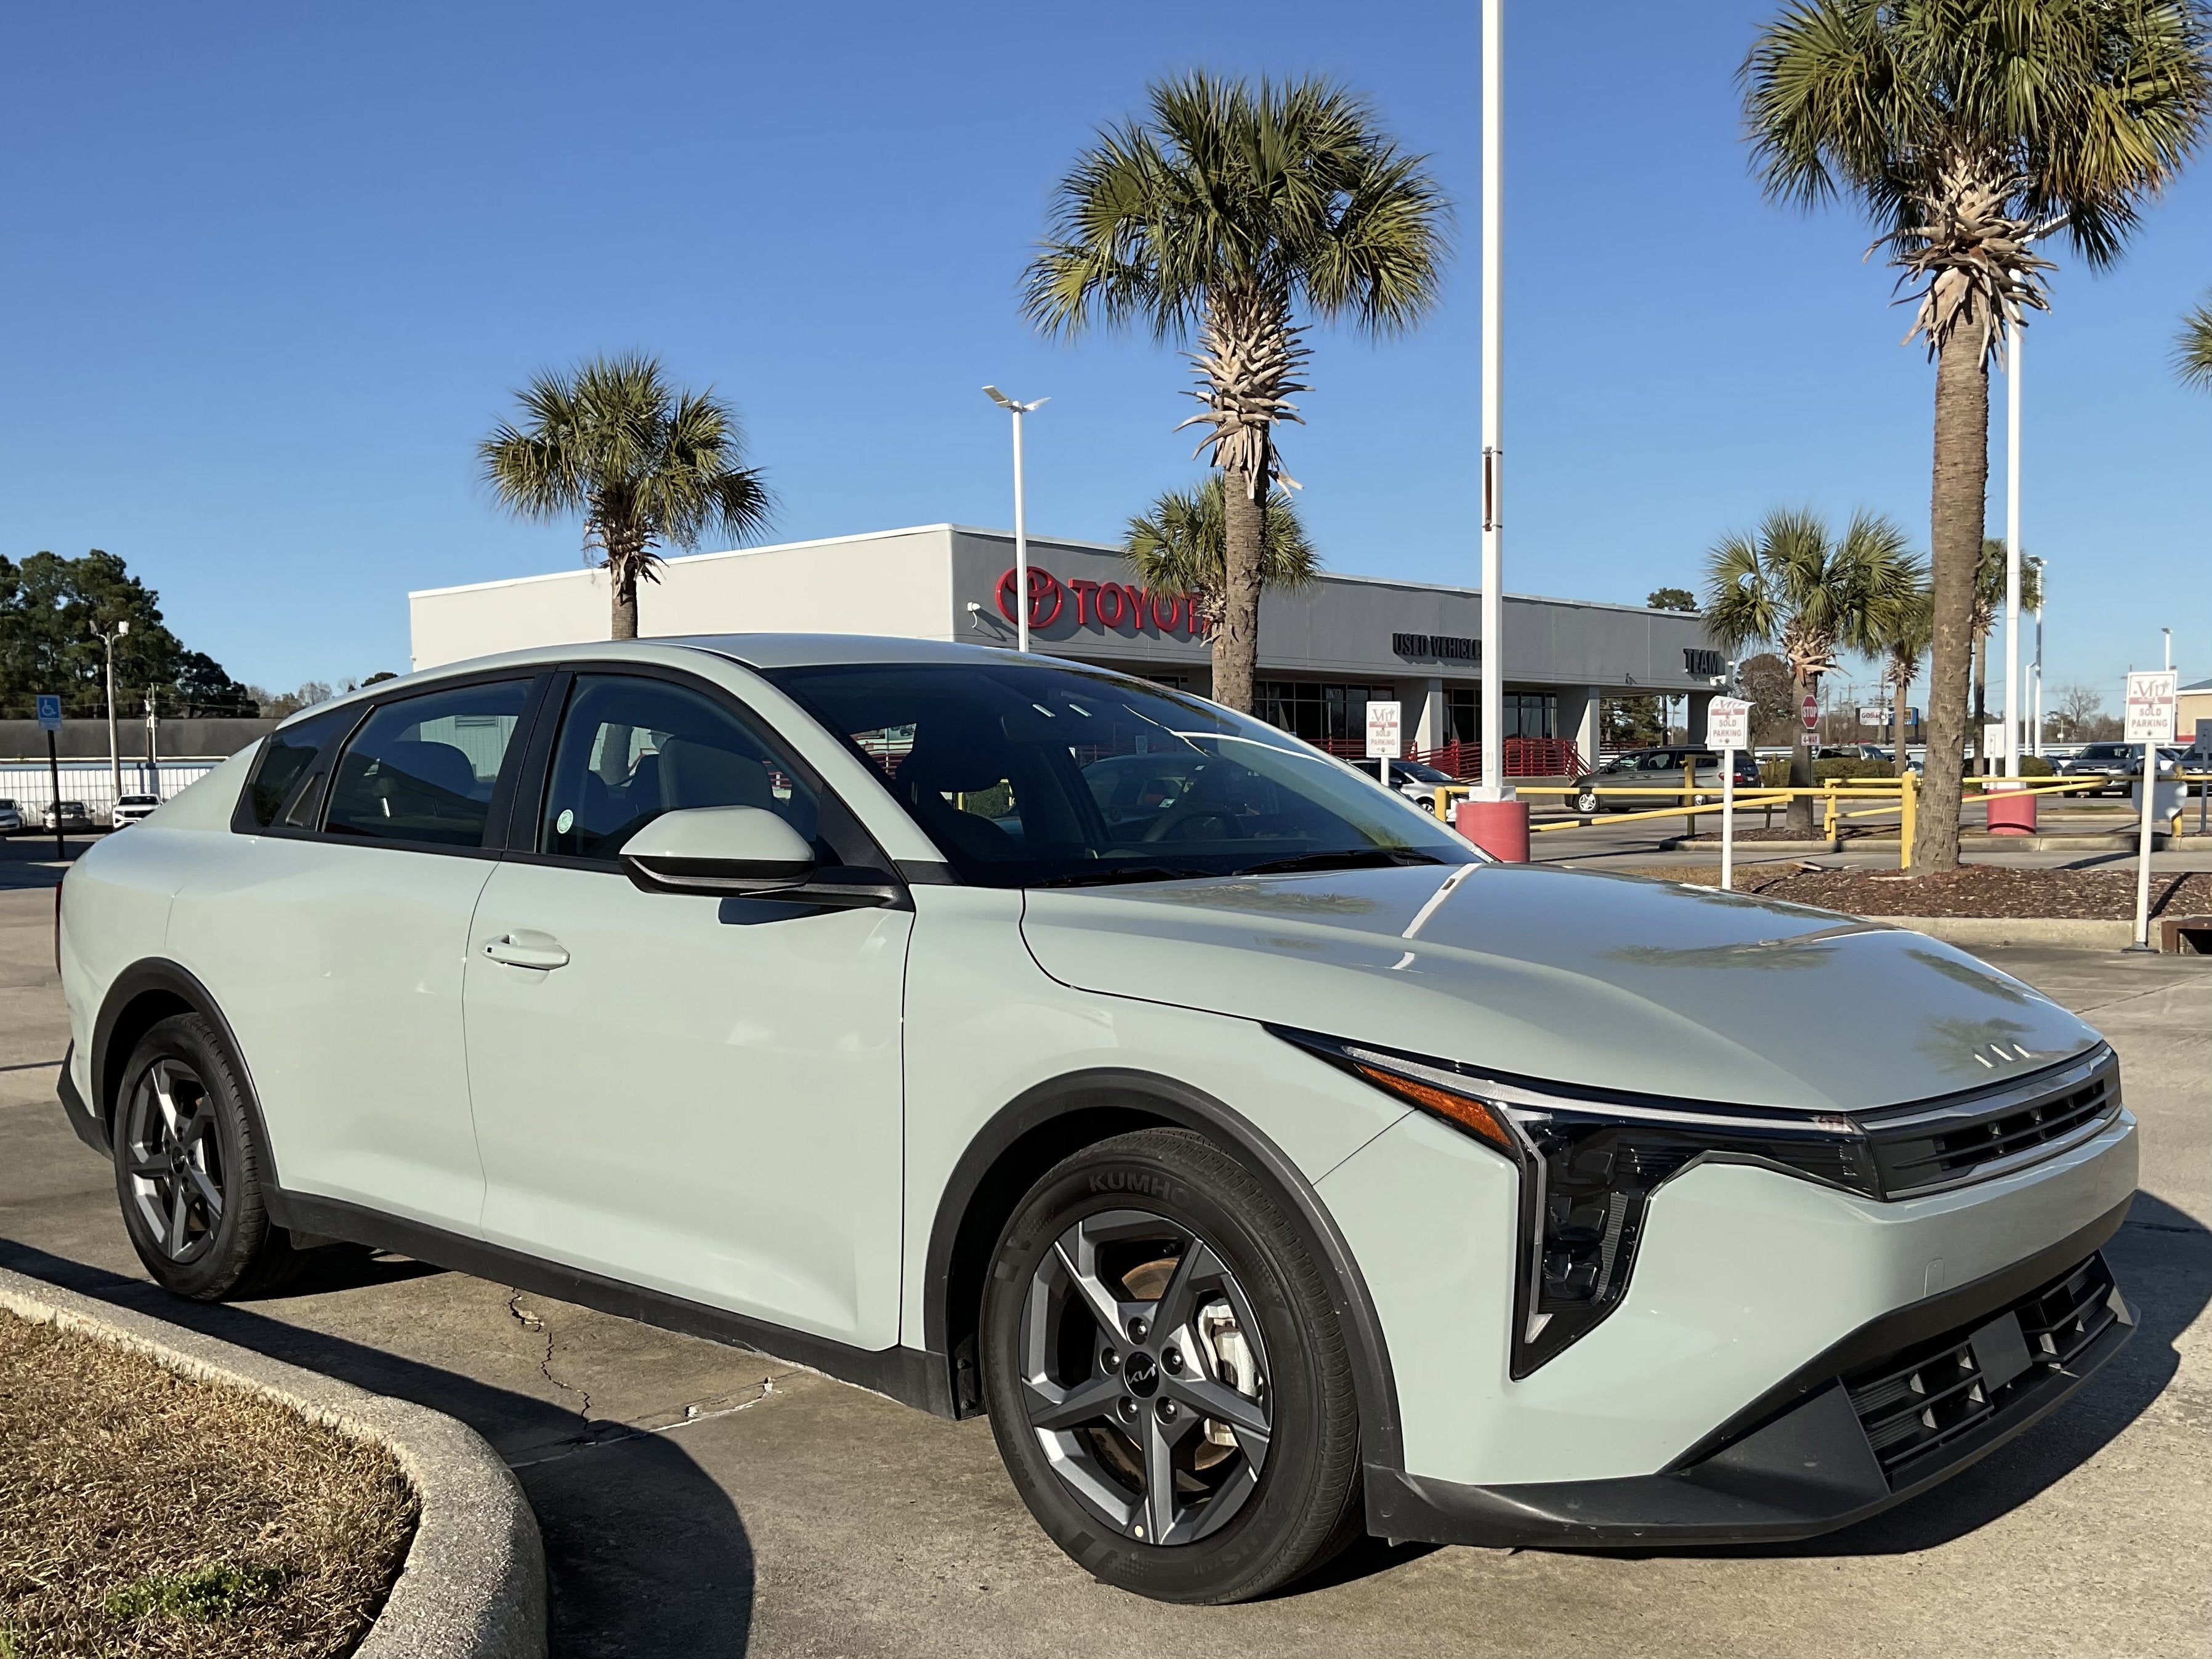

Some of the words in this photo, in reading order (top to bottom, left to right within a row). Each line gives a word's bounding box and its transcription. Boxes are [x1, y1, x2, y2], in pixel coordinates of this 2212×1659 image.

[1068, 578, 1213, 634] TOYOT
[1393, 633, 1429, 655] USED
[1430, 636, 1482, 660] VEHICLE
[1683, 648, 1718, 674] TEAM
[1802, 706, 1817, 718] STOP
[2139, 708, 2162, 716] SOLD
[1719, 719, 1737, 727] SOLD
[2131, 719, 2168, 727] PARKING
[1713, 729, 1742, 737] PARKING
[1803, 735, 1818, 743] 4-WAY
[1089, 1171, 1191, 1208] KUMHO
